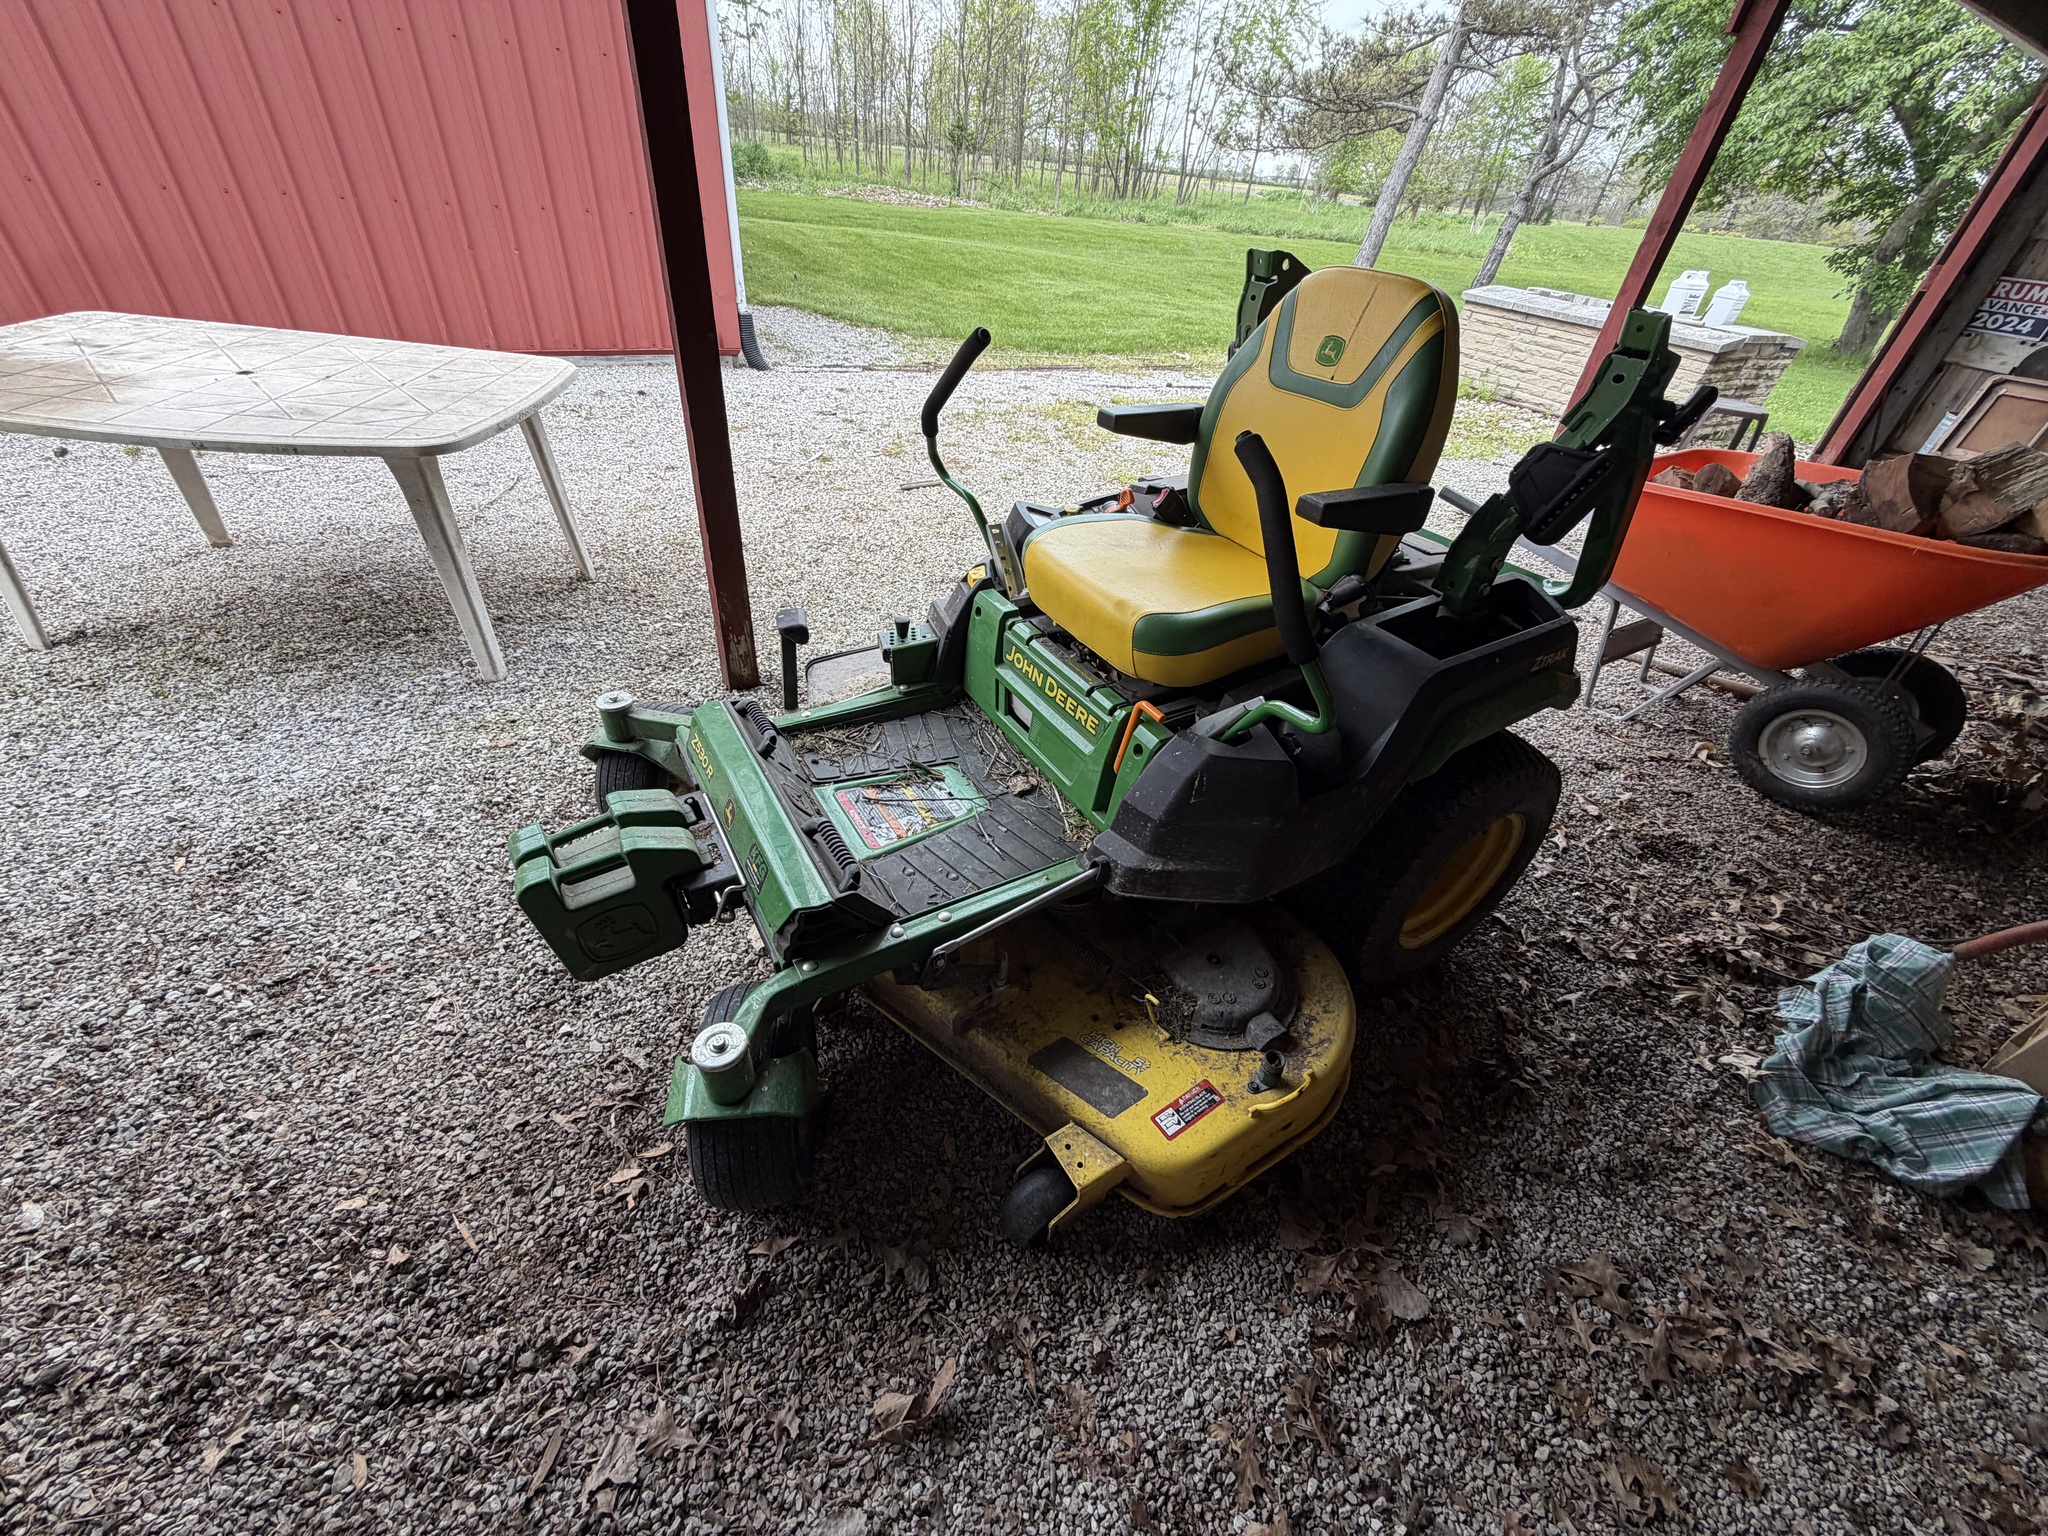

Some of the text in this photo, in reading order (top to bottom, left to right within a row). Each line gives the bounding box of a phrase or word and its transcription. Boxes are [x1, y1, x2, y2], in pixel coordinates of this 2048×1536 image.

[1991, 280, 2048, 304] RUM
[1988, 299, 2042, 316] VANCE
[1971, 311, 2036, 334] 2024
[1005, 645, 1045, 688] JOHN
[1044, 675, 1100, 736] DEERE
[1089, 1030, 1123, 1054] HIGH
[1079, 1034, 1143, 1076] CAPACITY
